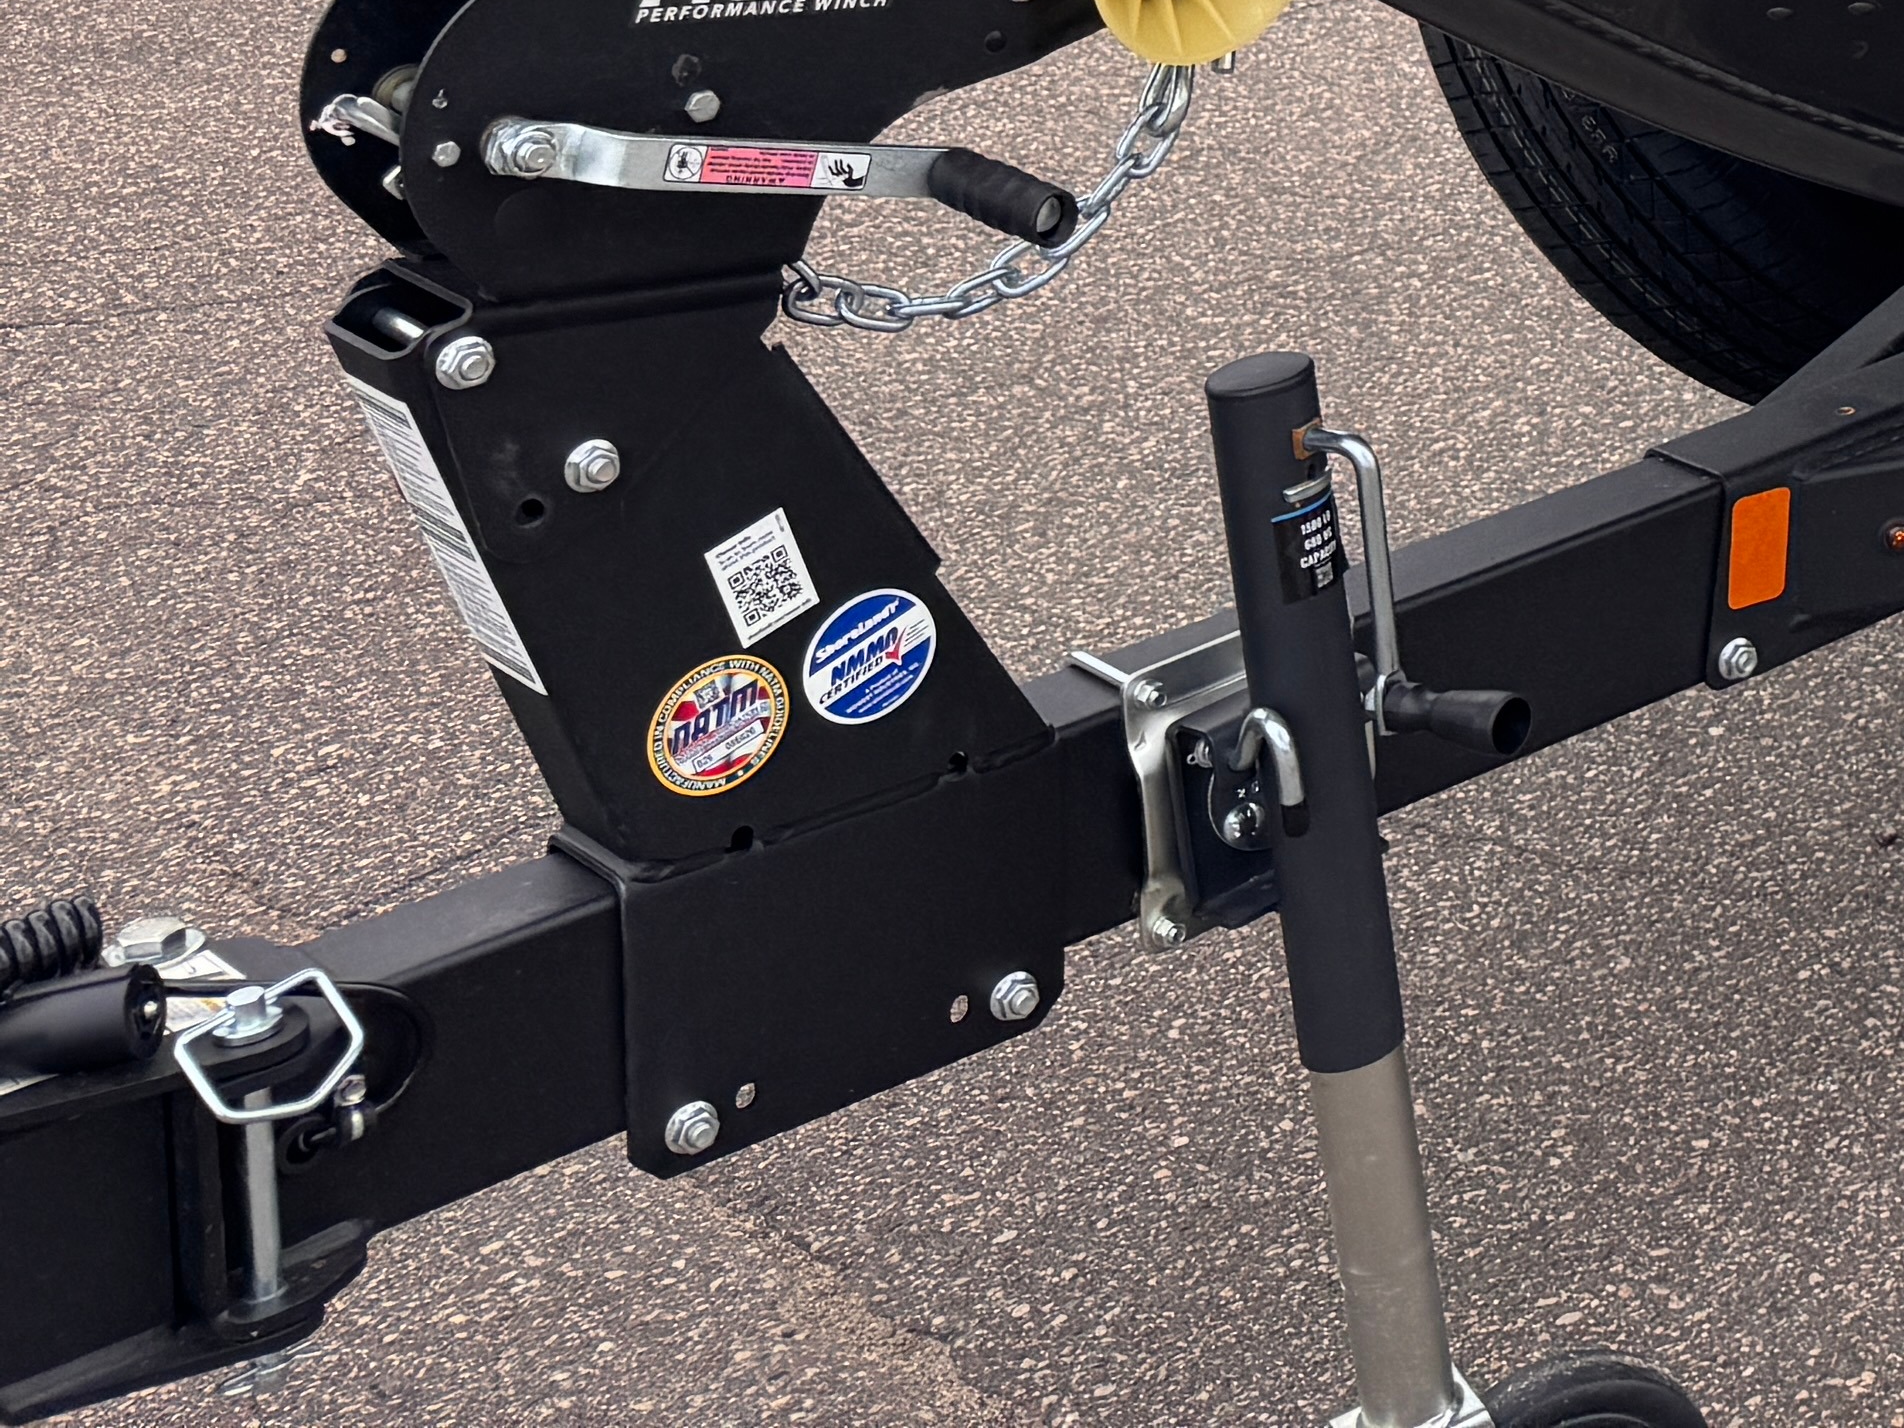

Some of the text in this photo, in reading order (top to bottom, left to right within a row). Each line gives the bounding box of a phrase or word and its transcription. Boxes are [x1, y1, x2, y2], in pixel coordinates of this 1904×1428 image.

[819, 655, 884, 705] CERTIFIED
[831, 626, 899, 687] NMMA
[658, 661, 727, 723] COMPLIANCE
[729, 659, 761, 672] WITH
